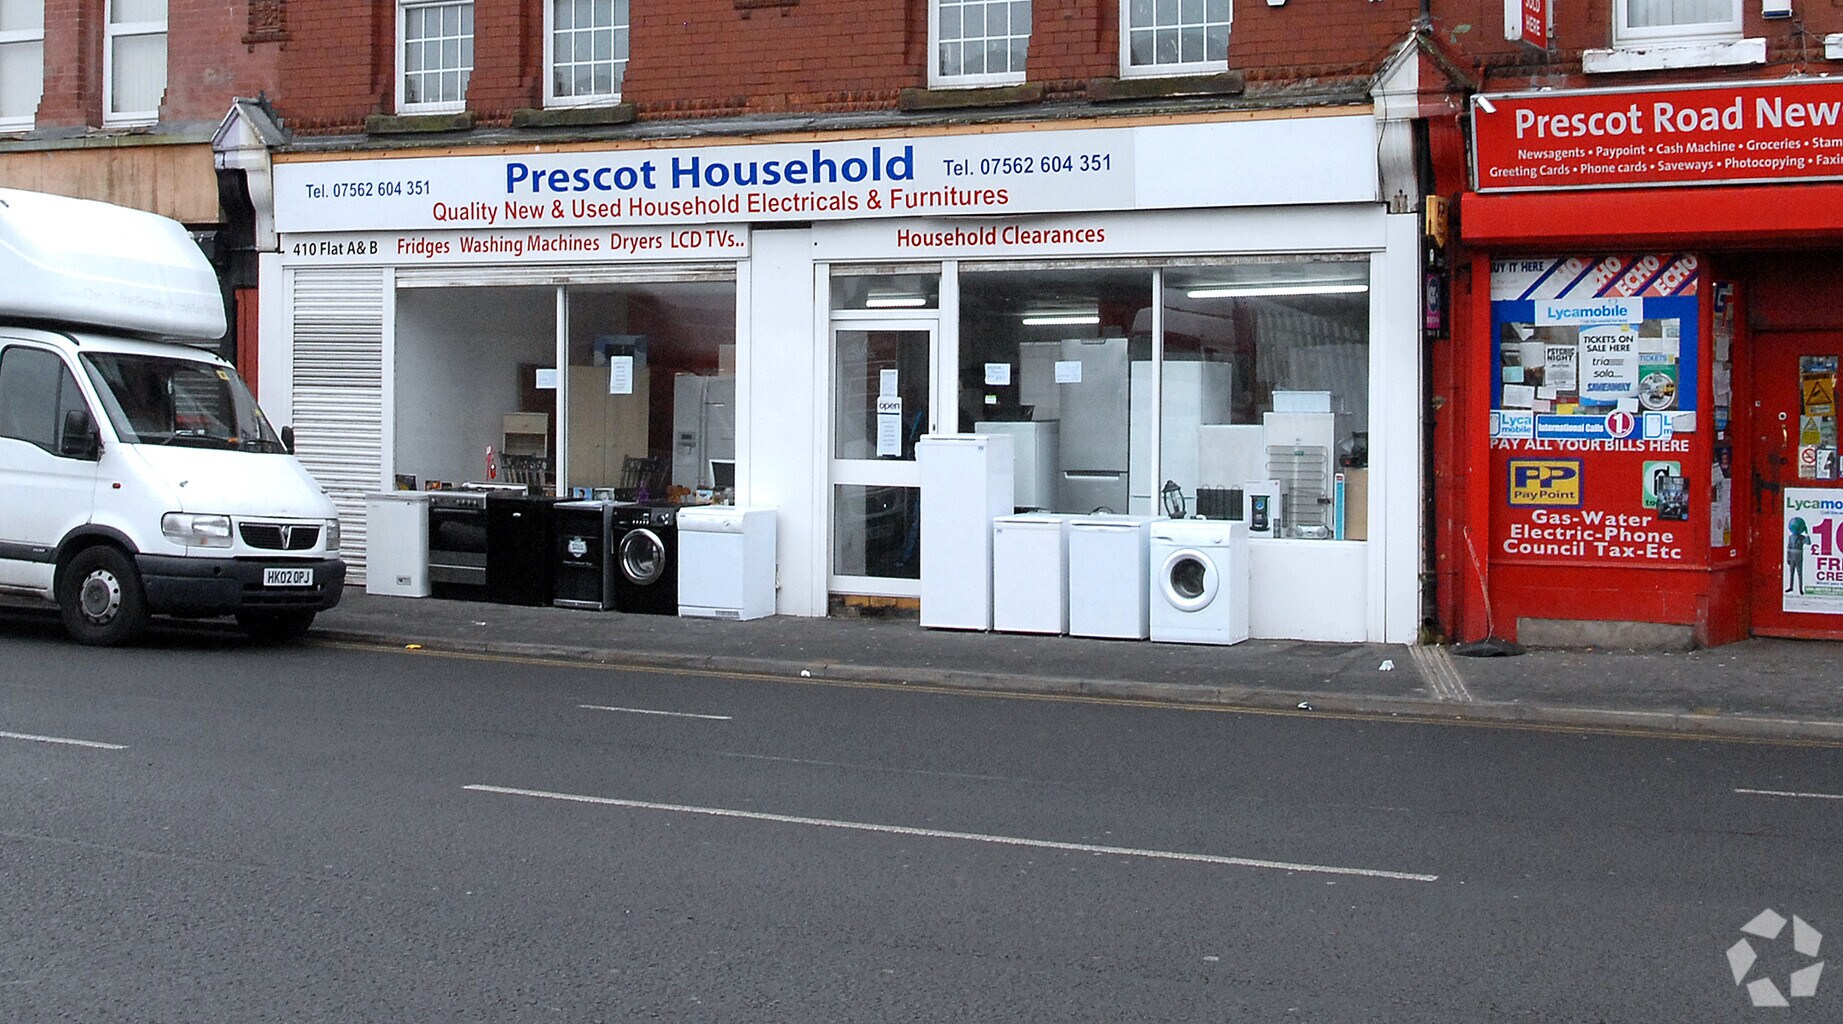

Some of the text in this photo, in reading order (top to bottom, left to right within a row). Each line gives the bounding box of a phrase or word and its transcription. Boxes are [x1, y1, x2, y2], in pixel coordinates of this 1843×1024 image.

[1525, 13, 1541, 36] HERE
[1515, 96, 1843, 139] Prescot Road New
[1518, 147, 1586, 161] Newsagents
[1595, 144, 1646, 159] Paypoint
[1656, 142, 1683, 155] Cash
[1686, 140, 1736, 154] Machine
[1746, 137, 1801, 151] Groceries
[507, 144, 915, 194] Prescot Household
[943, 153, 1111, 176] Tel. 07562 604 351
[1489, 165, 1537, 179] Greeting
[1539, 164, 1571, 176] Cards
[1580, 162, 1616, 175] Phone
[1617, 160, 1648, 172] cards
[1657, 158, 1714, 173] Saveways
[1724, 155, 1805, 170] Photocopying
[306, 180, 431, 198] Tel. 07562 604 351
[432, 185, 1009, 225] Quality New & Used Household Electricals & Furnitures
[397, 236, 450, 259] Fridges
[460, 234, 523, 258] Washing
[527, 232, 600, 252] Machines
[610, 232, 663, 254] Dryers
[671, 230, 702, 249] LCD
[897, 225, 1105, 248] Household Clearances
[293, 241, 317, 257] 410
[320, 240, 343, 256] Flat
[369, 240, 379, 255] B
[1491, 262, 1505, 273] UY
[1509, 262, 1518, 273] IT
[1521, 261, 1545, 272] HERE
[1615, 255, 1660, 297] ECHO
[1653, 254, 1698, 297] ECHO
[1547, 305, 1628, 321] Lycamobile
[1583, 335, 1634, 344] TICKETS ON
[1586, 344, 1631, 353] SALE HERE
[1547, 354, 1573, 362] NIGHT
[879, 402, 900, 411] open
[1501, 414, 1532, 426] Lyca
[1501, 425, 1532, 433] mobile
[1538, 423, 1604, 433] International Calls
[1490, 439, 1690, 452] PAY ALL YOUR BILLS HERE
[1531, 509, 1653, 527] Gas-Water
[1510, 523, 1674, 543] Electric-Phone
[1503, 538, 1682, 559] Council Tax-Etc
[1817, 557, 1843, 571] FR
